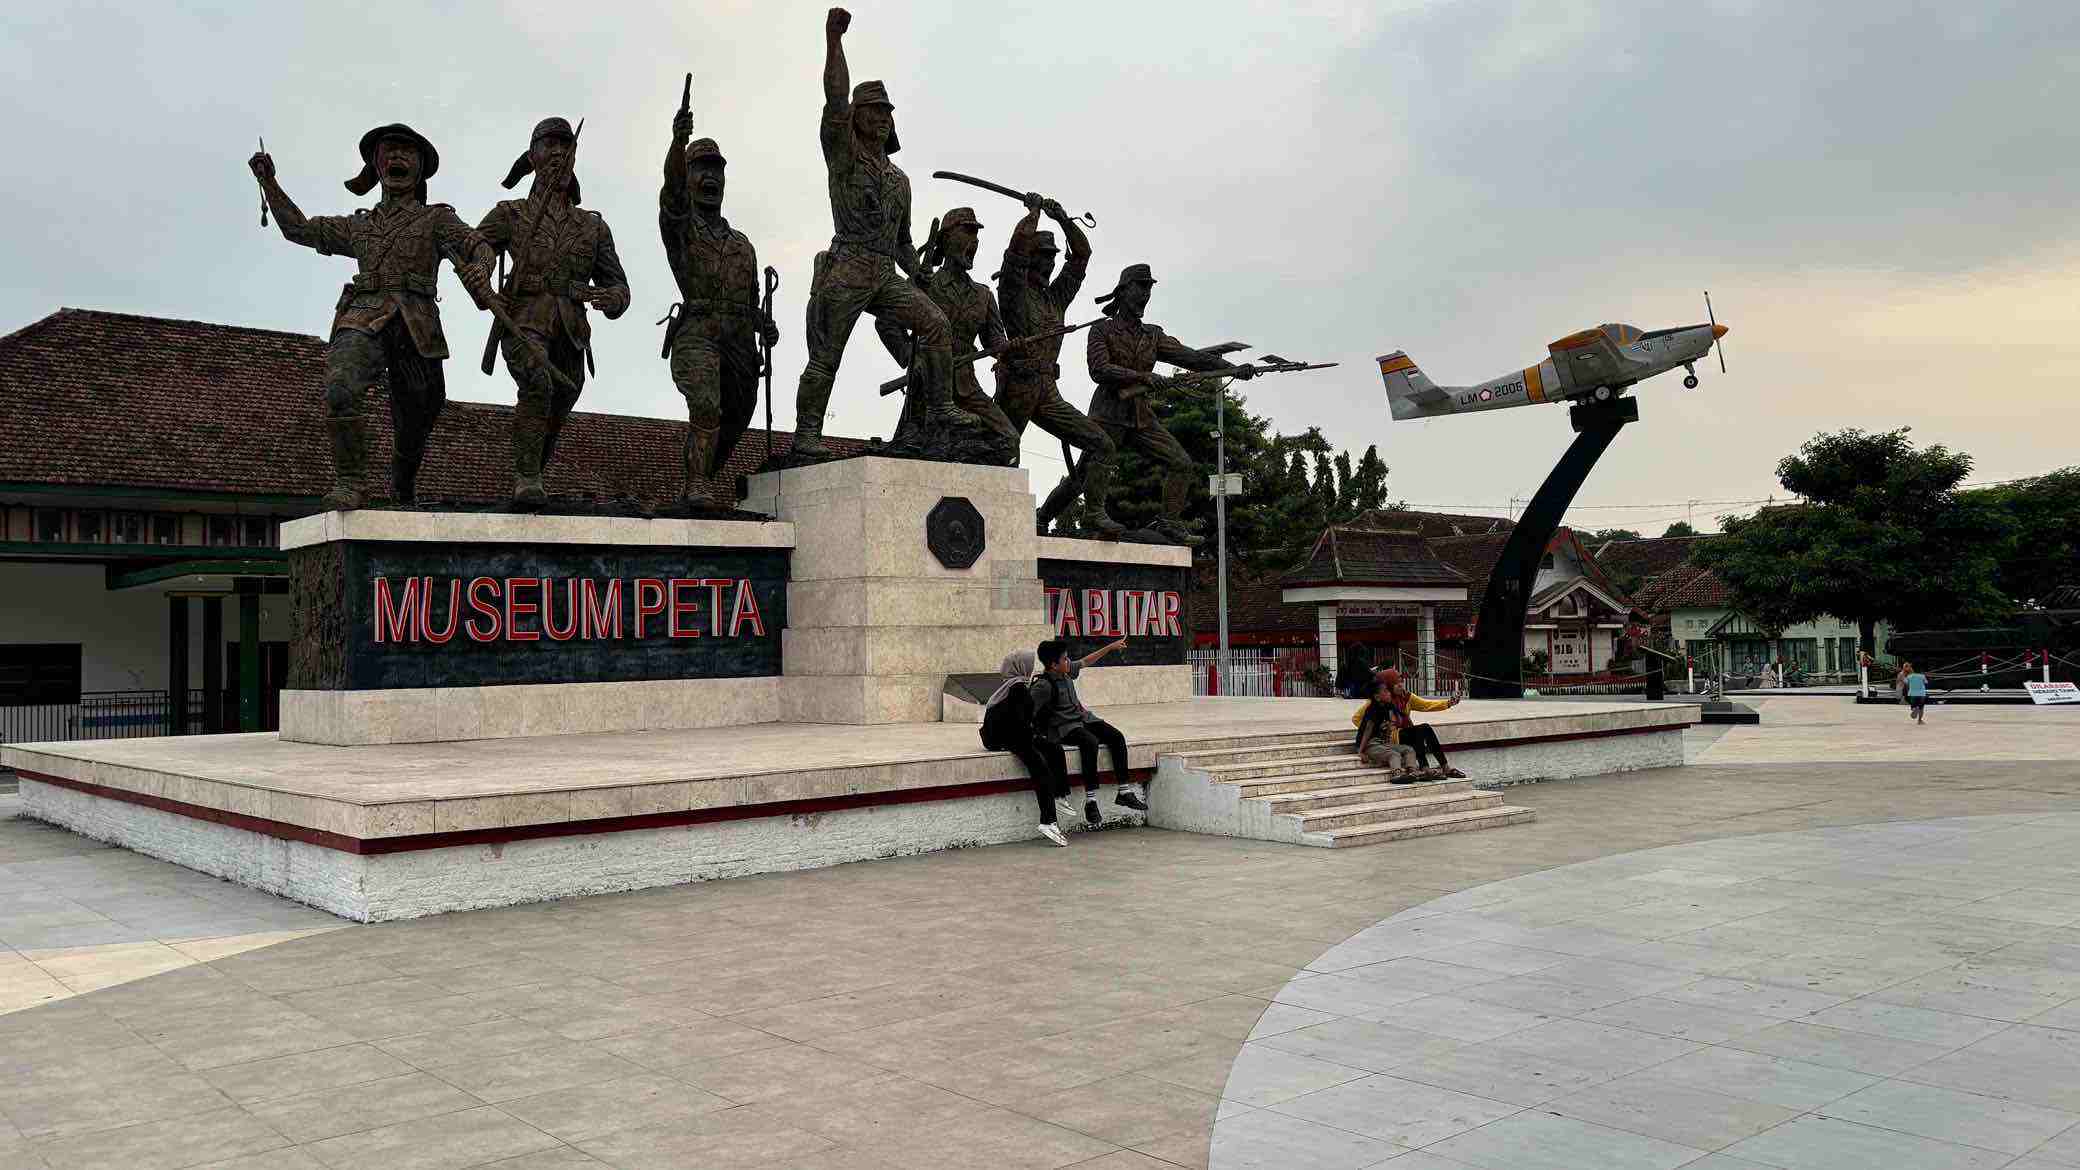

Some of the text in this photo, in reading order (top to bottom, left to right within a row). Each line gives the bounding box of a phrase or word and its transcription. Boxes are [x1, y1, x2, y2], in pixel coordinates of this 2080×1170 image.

[1460, 381, 1523, 405] LM 2006
[373, 576, 765, 643] MUSEUM PETA
[1082, 588, 1183, 637] BLITAR
